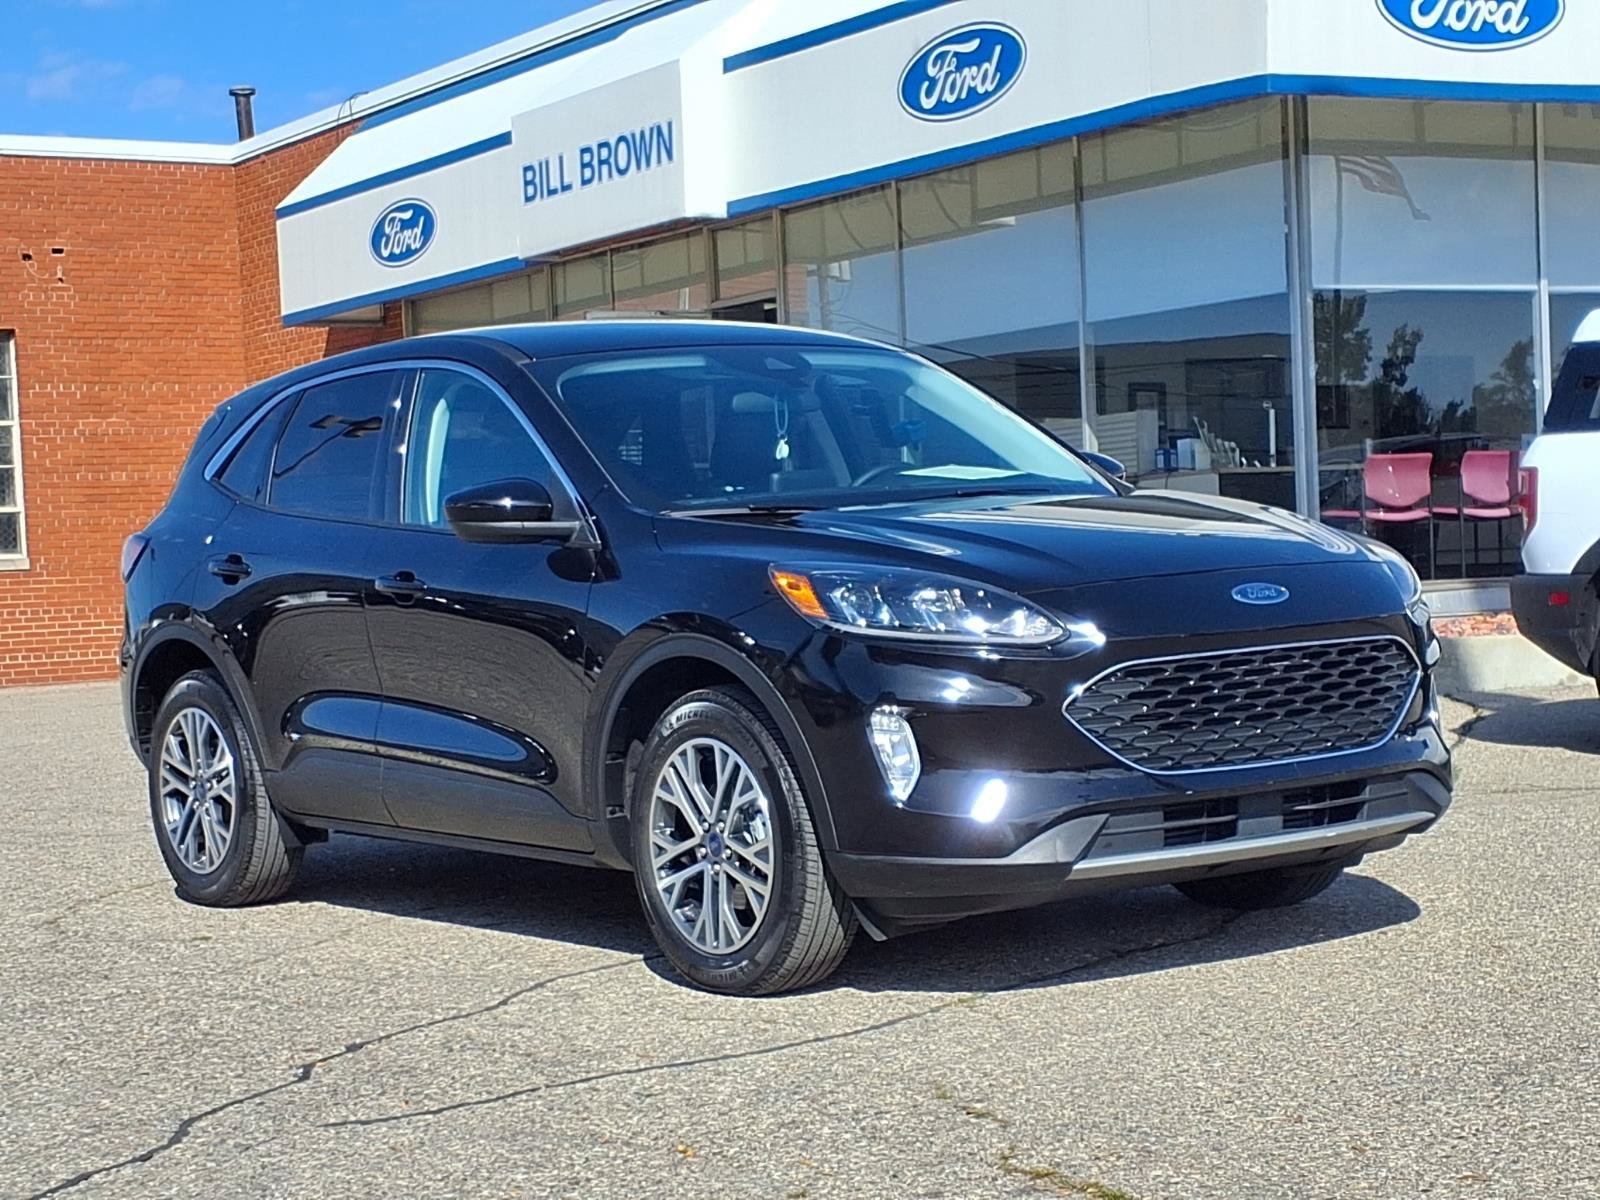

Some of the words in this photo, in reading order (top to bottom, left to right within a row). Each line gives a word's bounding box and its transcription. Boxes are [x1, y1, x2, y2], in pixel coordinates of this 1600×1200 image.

[920, 37, 1002, 109] Ford
[522, 154, 573, 203] BILL
[579, 120, 674, 187] BROWN
[381, 208, 425, 258] Ford
[1246, 587, 1278, 599] Ford
[675, 708, 722, 723] MICHE
